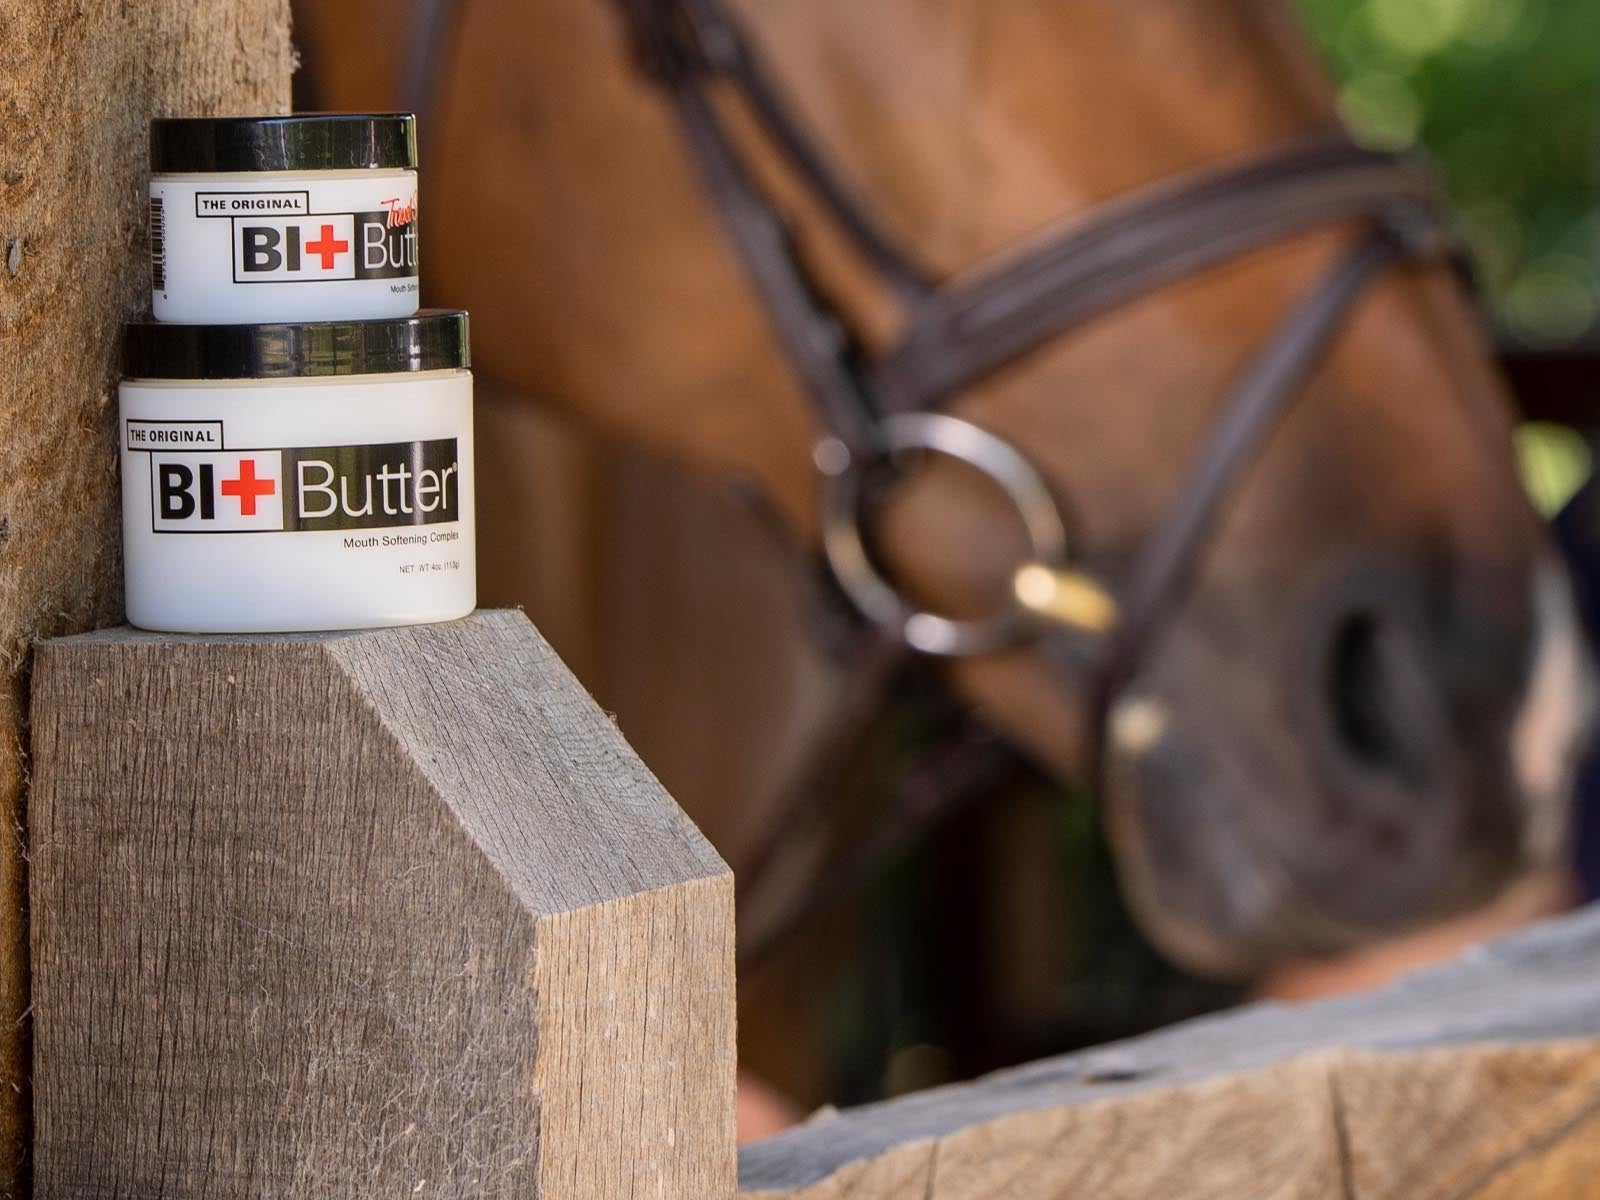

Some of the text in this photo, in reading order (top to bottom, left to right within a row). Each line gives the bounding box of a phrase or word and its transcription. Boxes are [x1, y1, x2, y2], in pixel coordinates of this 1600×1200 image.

[202, 198, 301, 211] THE ORIGINAL
[363, 222, 418, 269] Butt
[130, 429, 215, 443] THE ORIGINAL
[343, 530, 459, 549] Mouth Softening Complex
[399, 564, 414, 574] NET
[418, 562, 430, 572] WT
